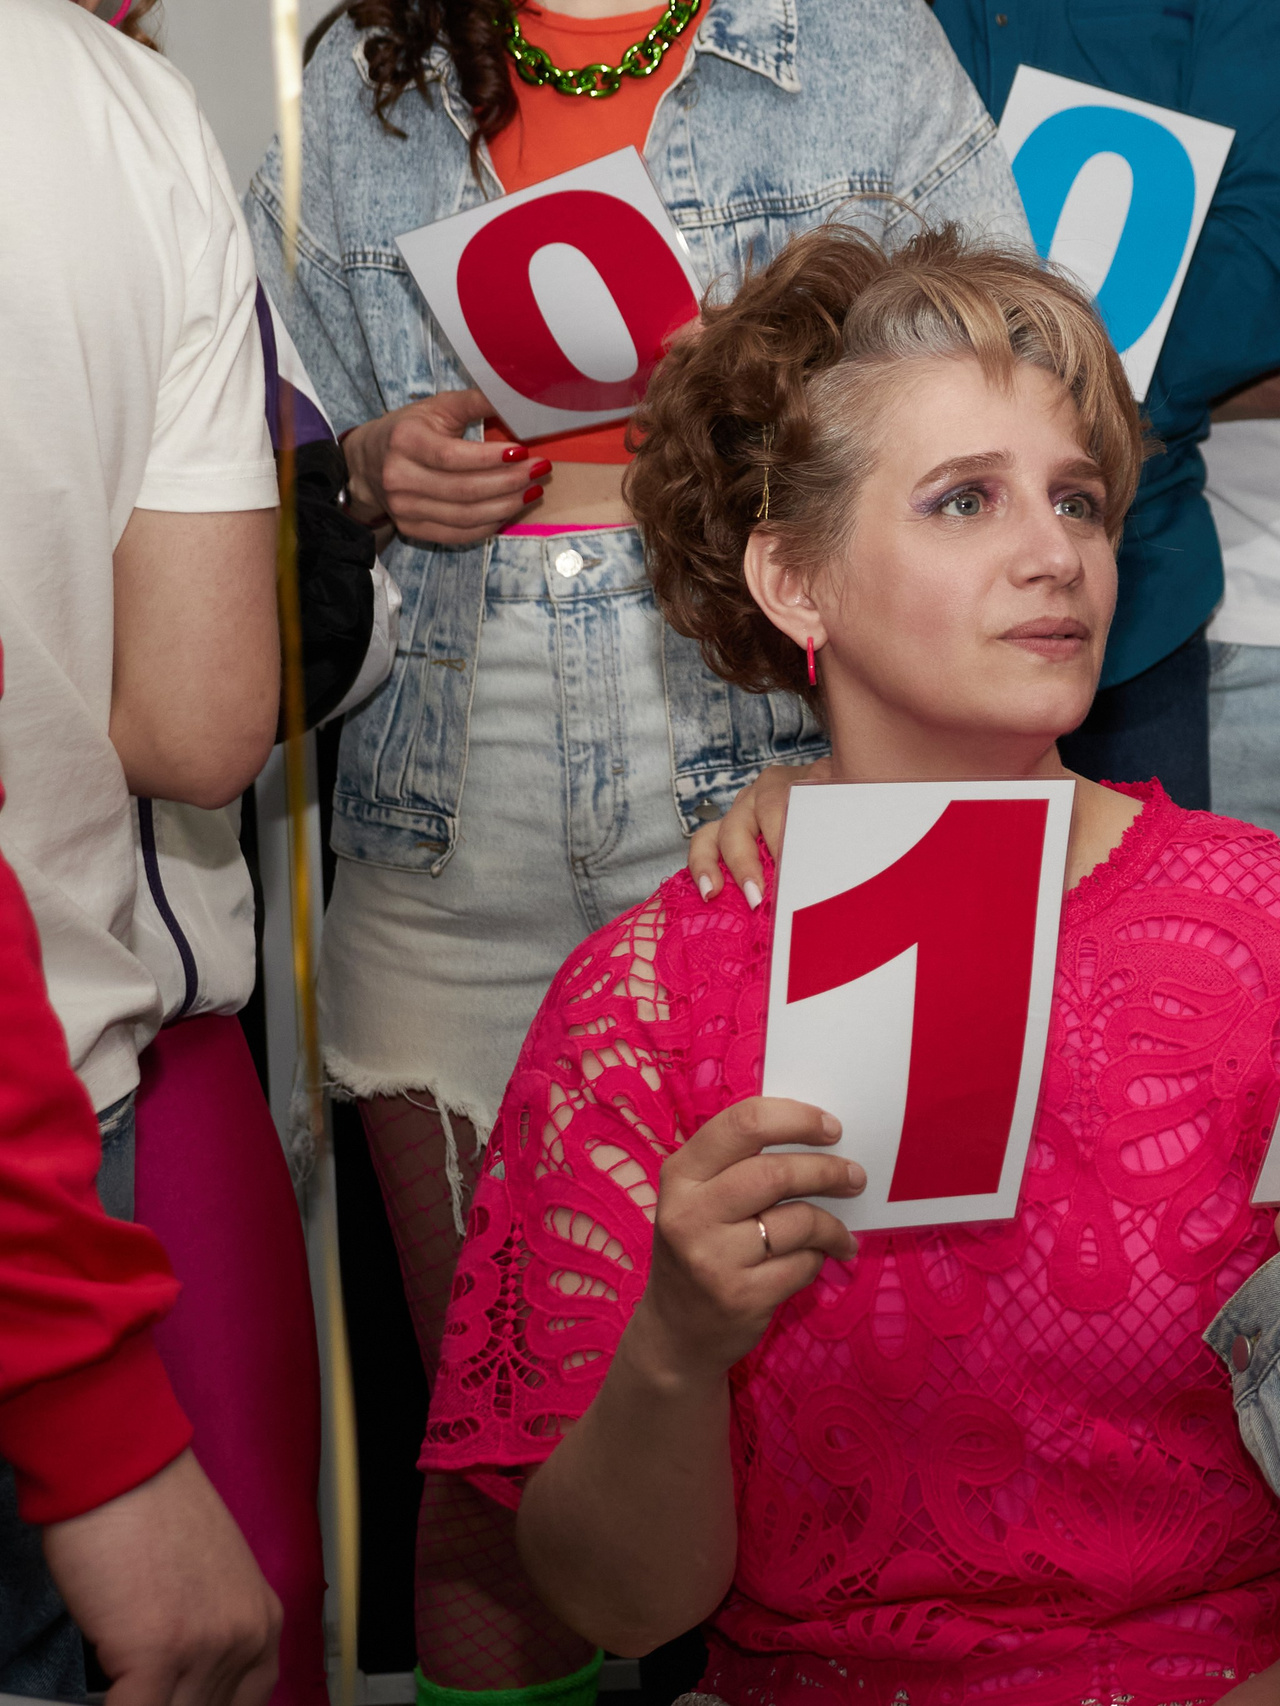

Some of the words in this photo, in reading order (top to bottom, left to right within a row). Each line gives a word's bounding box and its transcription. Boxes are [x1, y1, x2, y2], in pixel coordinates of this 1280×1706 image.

[457, 190, 701, 411] 0
[1011, 104, 1196, 354] 0
[786, 798, 1050, 1203] 1
